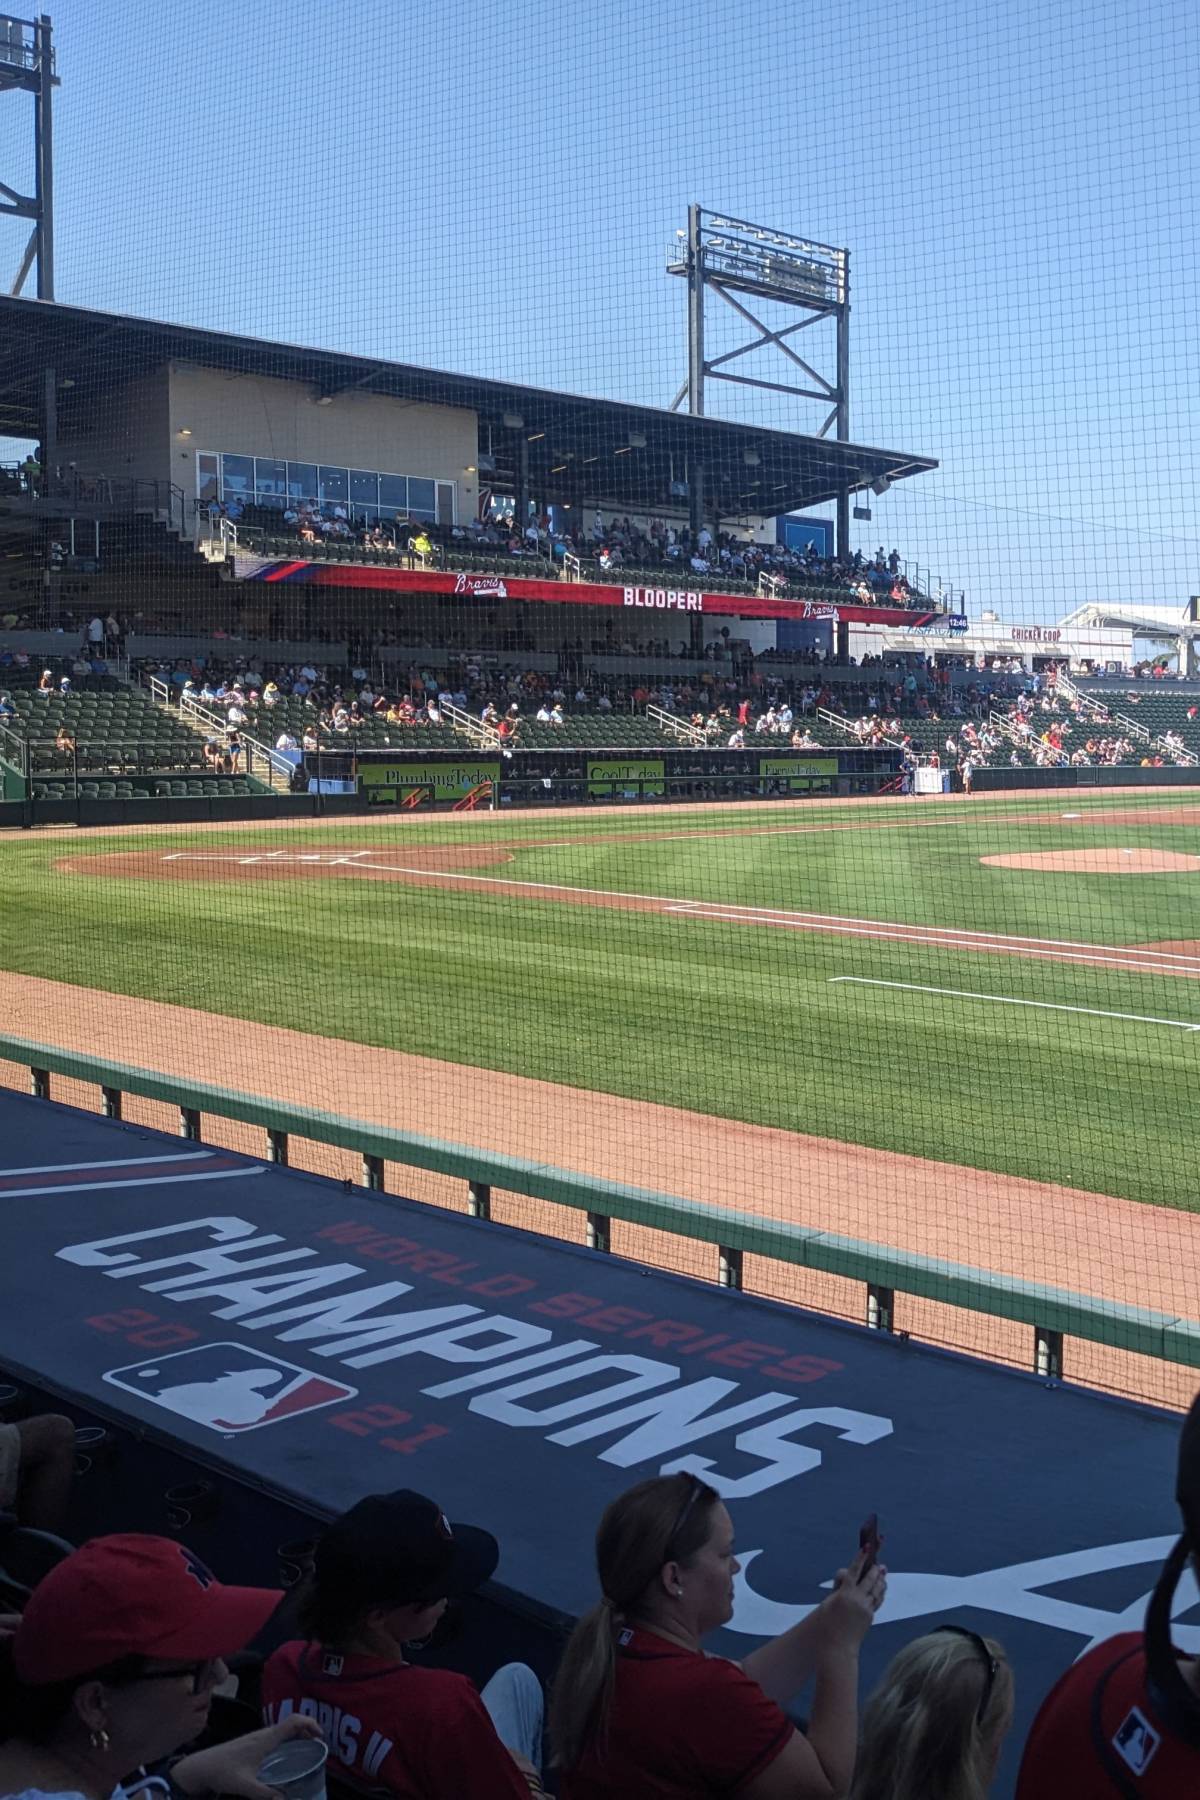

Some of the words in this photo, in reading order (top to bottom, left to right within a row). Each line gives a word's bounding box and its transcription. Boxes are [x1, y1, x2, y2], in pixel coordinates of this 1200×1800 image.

[624, 587, 703, 611] BLOOPER!
[949, 618, 967, 628] 12:46
[1011, 627, 1041, 641] CHICKEN
[1043, 629, 1062, 642] COOP
[316, 1220, 538, 1298] WORLD
[528, 1291, 845, 1384] SERIES
[54, 1216, 894, 1499] CHAMPIONS
